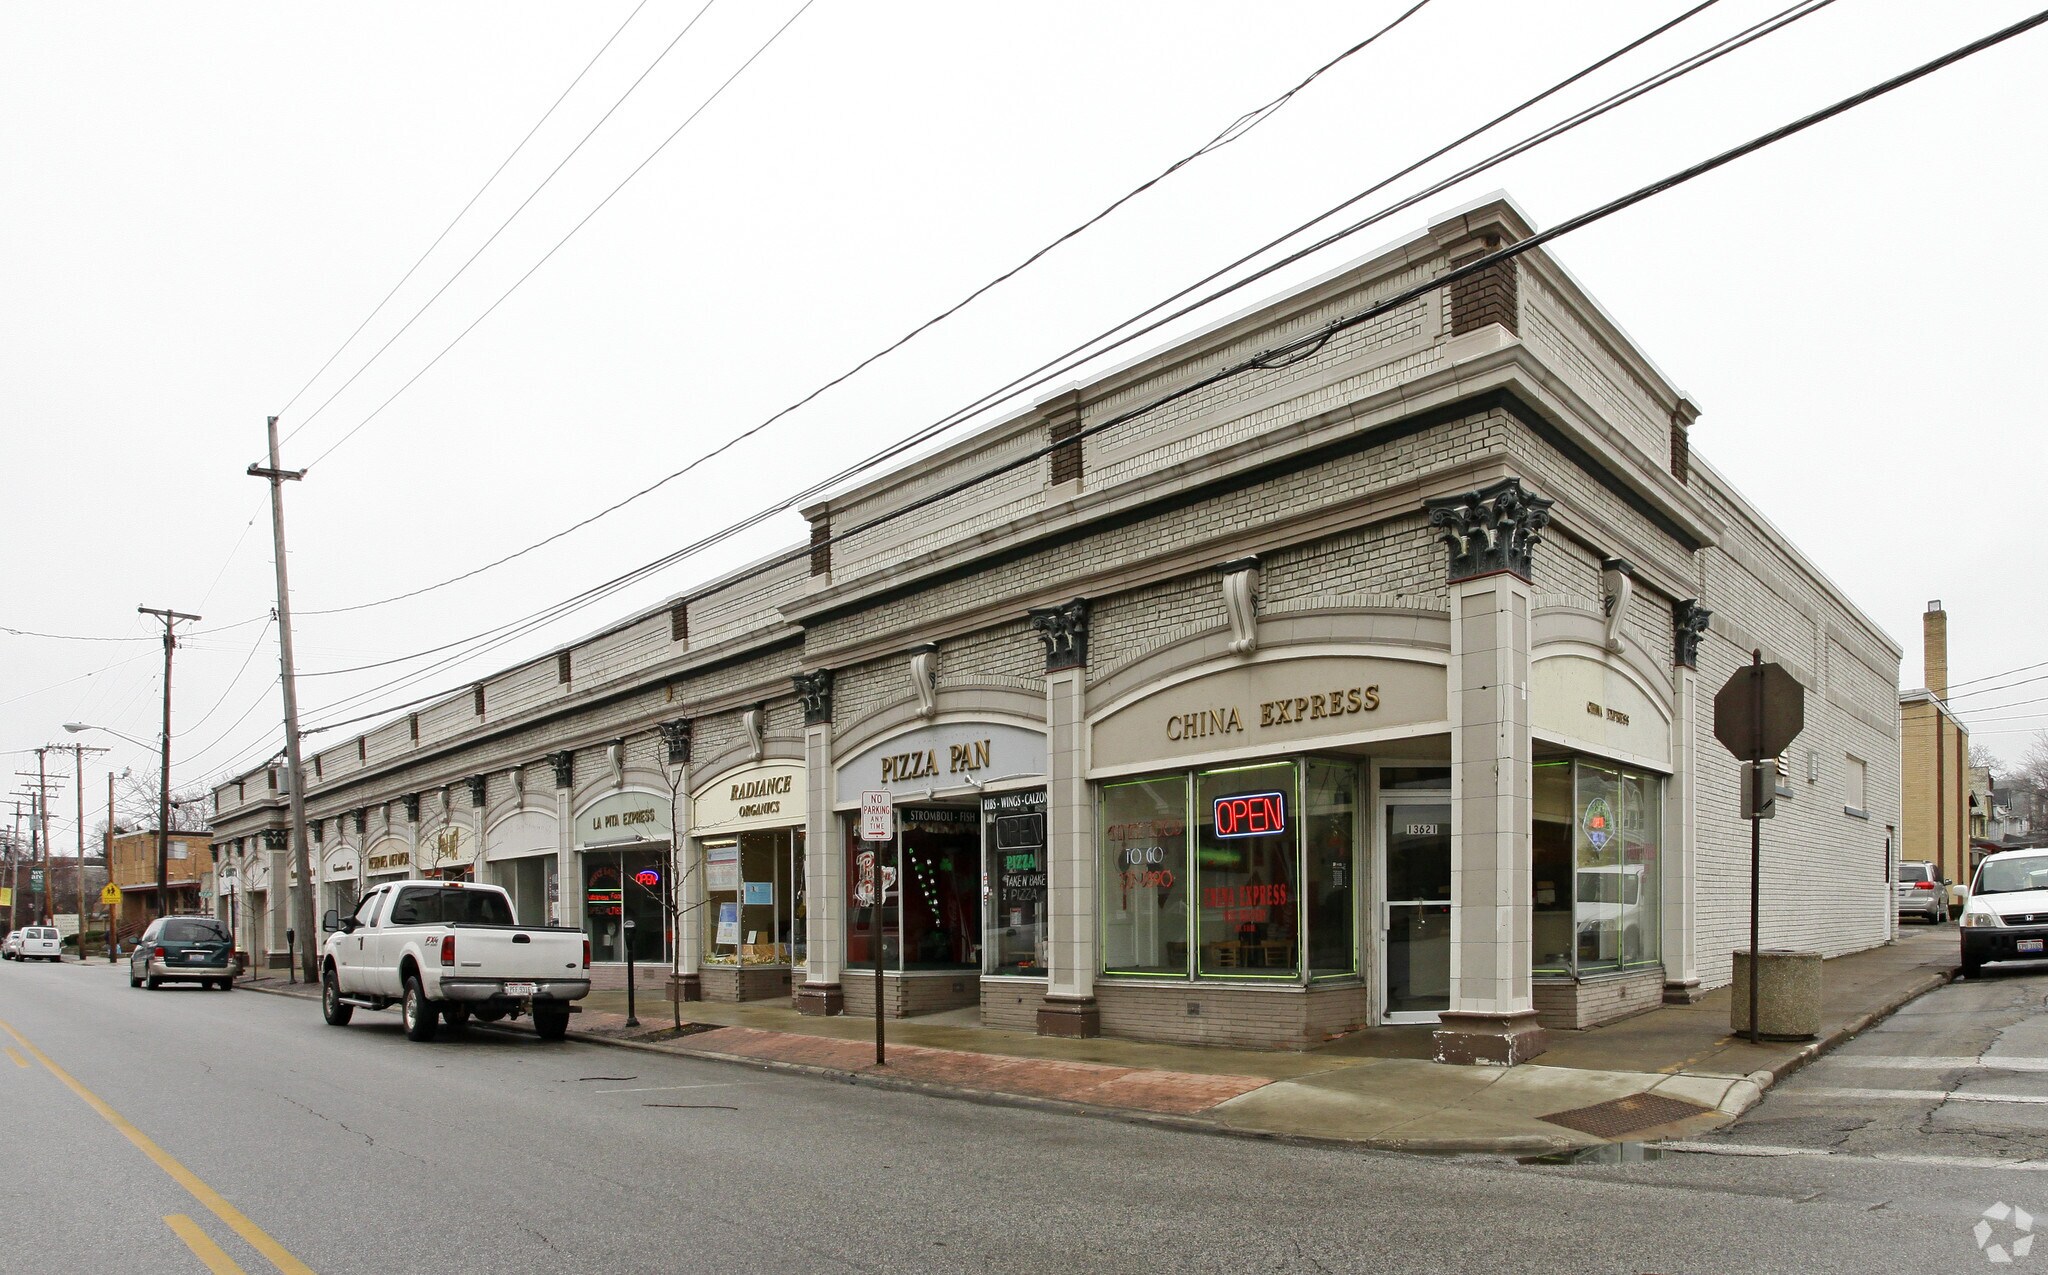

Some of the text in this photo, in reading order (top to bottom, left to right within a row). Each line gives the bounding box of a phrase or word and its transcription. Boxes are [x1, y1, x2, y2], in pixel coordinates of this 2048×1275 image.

[1166, 684, 1380, 741] CHINA EXPRESS
[881, 739, 991, 783] PIZZA PAN
[730, 775, 792, 801] RADIANCE
[870, 794, 883, 804] NO
[984, 799, 997, 811] RIBS
[1000, 795, 1021, 808] WINGS
[739, 800, 780, 818] ORGANICS
[863, 804, 890, 815] PARKING
[910, 810, 953, 822] STROMBOLI
[960, 812, 976, 822] FISH
[1217, 797, 1282, 834] OPEN
[593, 808, 655, 830] LA PITA EXPRESS
[999, 817, 1041, 847] OPEN
[1407, 824, 1437, 834] 13621
[1006, 853, 1036, 871] PIZZA
[1125, 846, 1164, 865] TO GO
[635, 873, 658, 886] OPEN
[1006, 875, 1022, 888] TAKE
[1029, 873, 1046, 886] BAKE
[1010, 888, 1038, 901] PIZZA
[1204, 883, 1288, 910] CHINA EXPRESS
